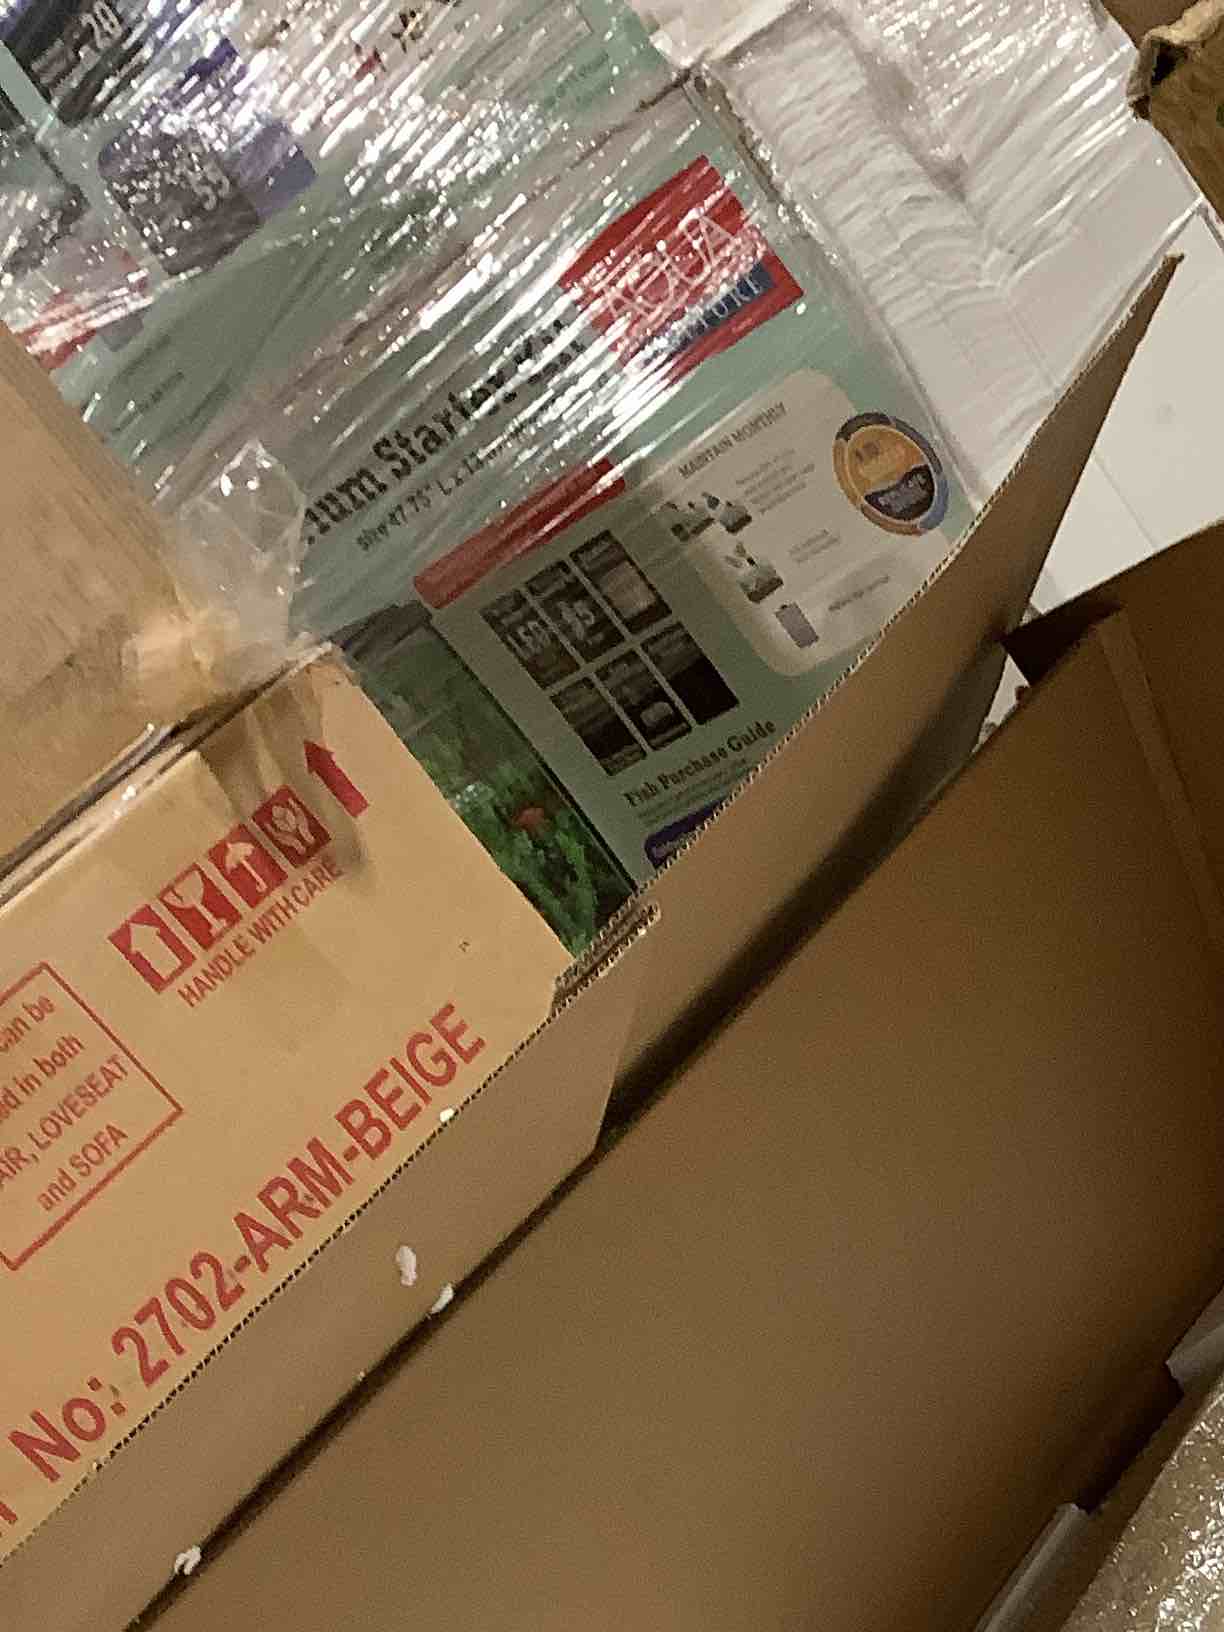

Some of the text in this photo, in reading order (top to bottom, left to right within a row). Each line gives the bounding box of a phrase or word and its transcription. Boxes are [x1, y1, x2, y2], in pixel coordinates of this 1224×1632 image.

[727, 719, 777, 755] Guide
[178, 860, 344, 1008] HANDLE WITH CARE
[28, 1054, 128, 1150] LOVESEAT
[33, 1034, 85, 1078] both
[37, 1123, 128, 1211] and SOFA
[8, 1003, 486, 1482] No: 2702-ARM-BEIGE
